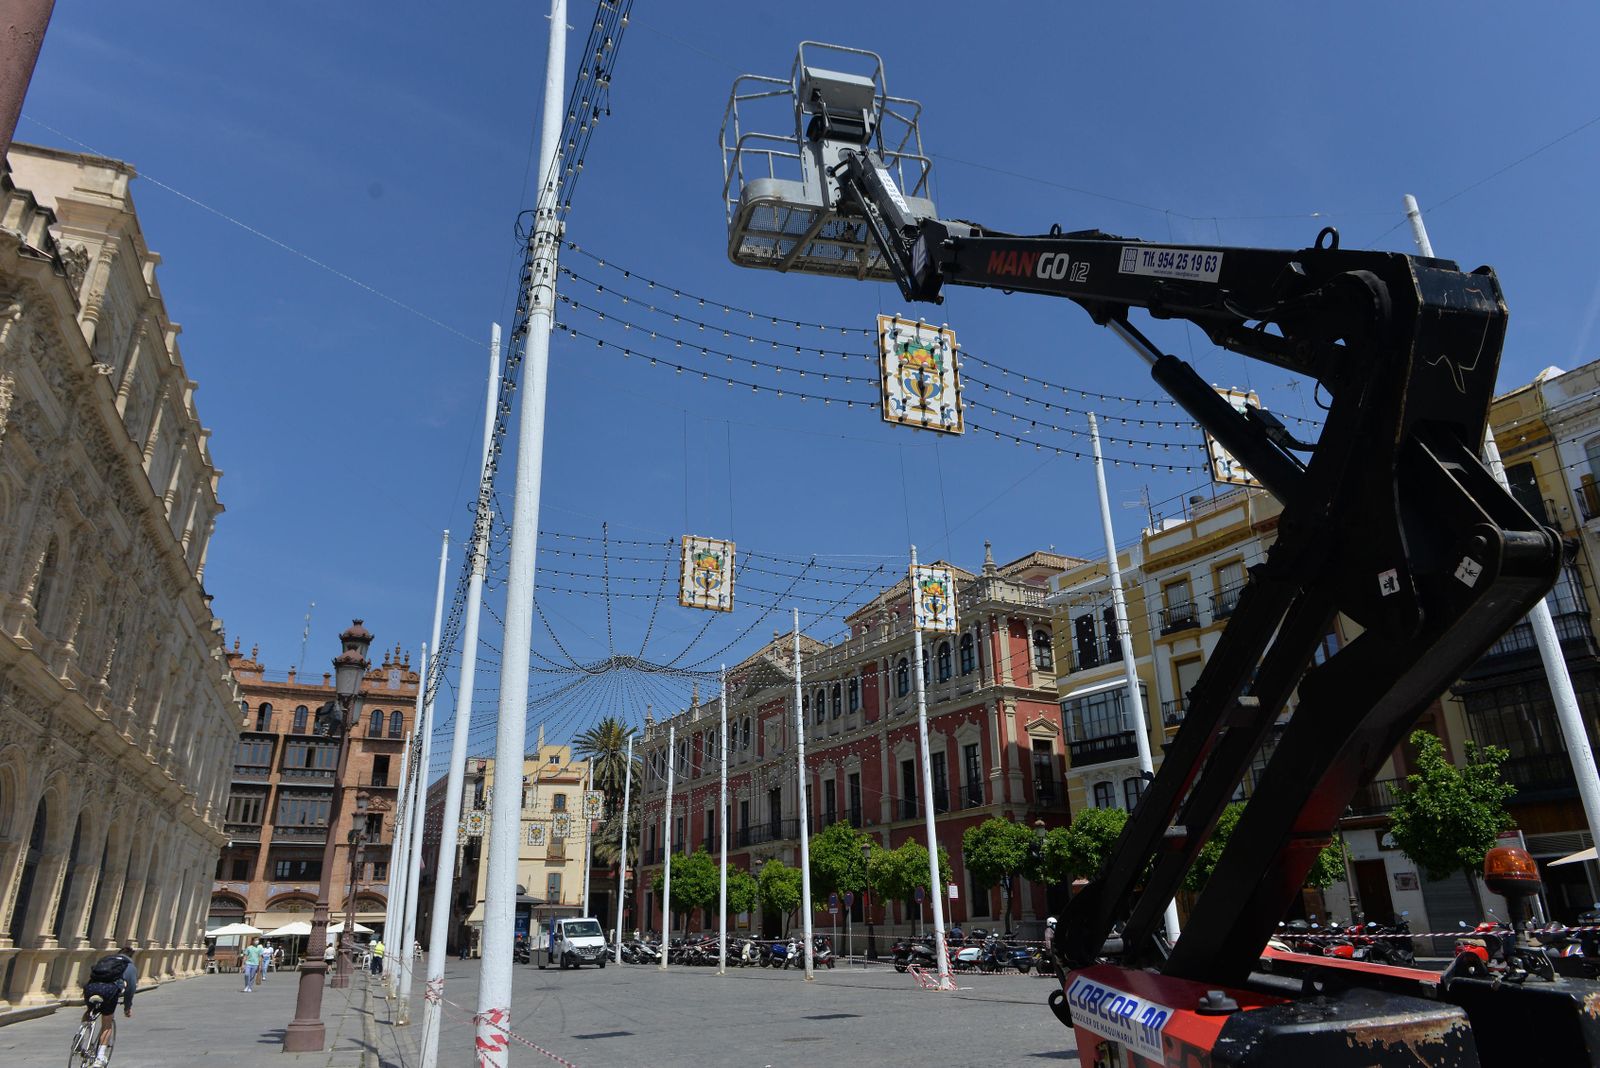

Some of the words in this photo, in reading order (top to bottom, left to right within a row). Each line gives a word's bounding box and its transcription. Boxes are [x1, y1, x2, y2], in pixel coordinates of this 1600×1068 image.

[1069, 262, 1090, 283] 12
[1157, 252, 1175, 269] 954
[1175, 253, 1189, 270] 25
[1191, 254, 1203, 271] 19
[1204, 255, 1218, 273] 63
[1069, 980, 1138, 1030] LOBCOR
